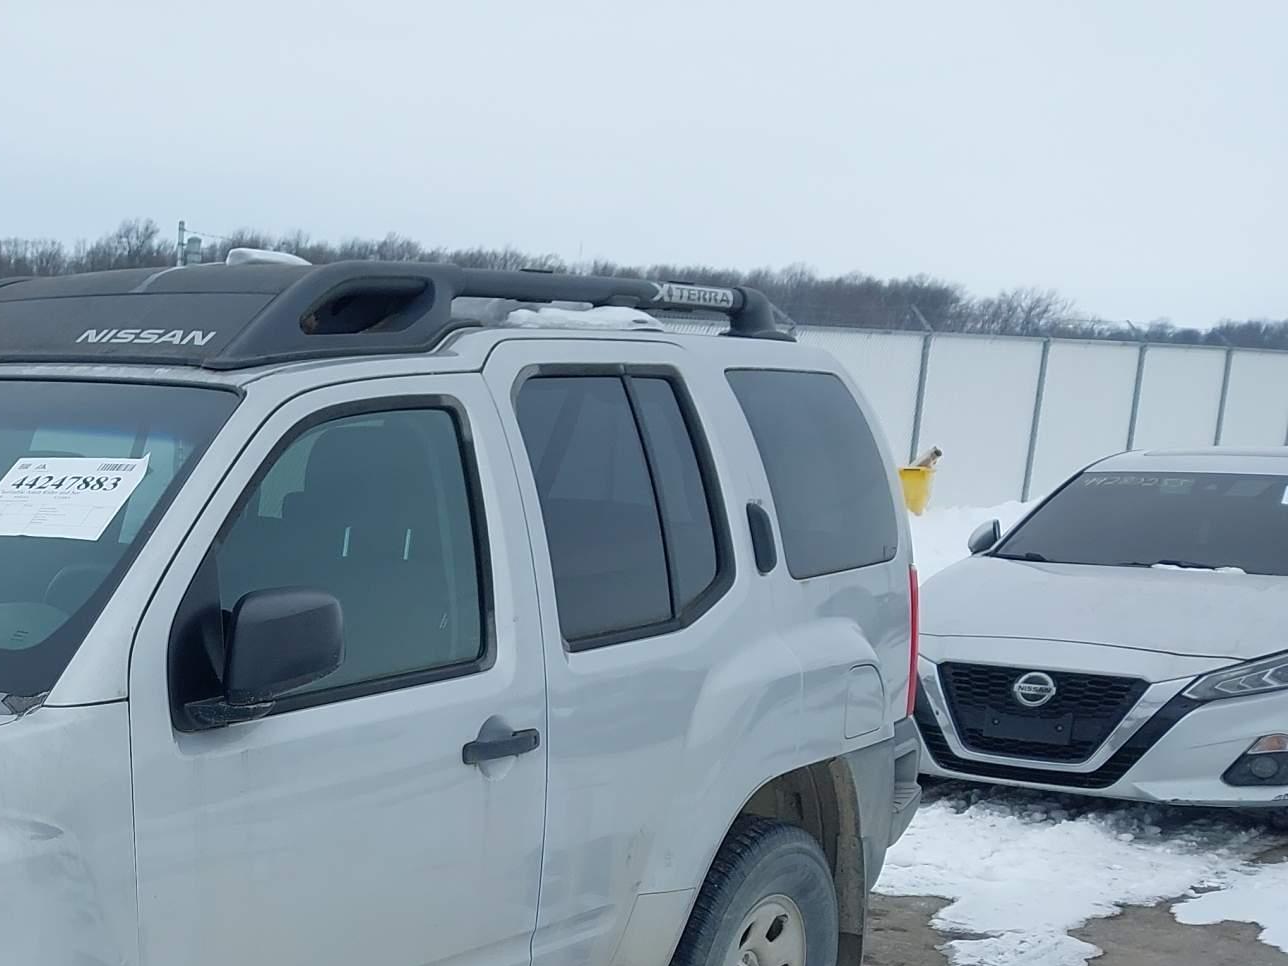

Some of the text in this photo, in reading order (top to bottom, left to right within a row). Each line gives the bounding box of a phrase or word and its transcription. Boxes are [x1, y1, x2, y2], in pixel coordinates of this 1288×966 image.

[649, 281, 730, 306] XTERRA
[75, 328, 217, 346] NISSAN
[12, 475, 123, 492] 44247883
